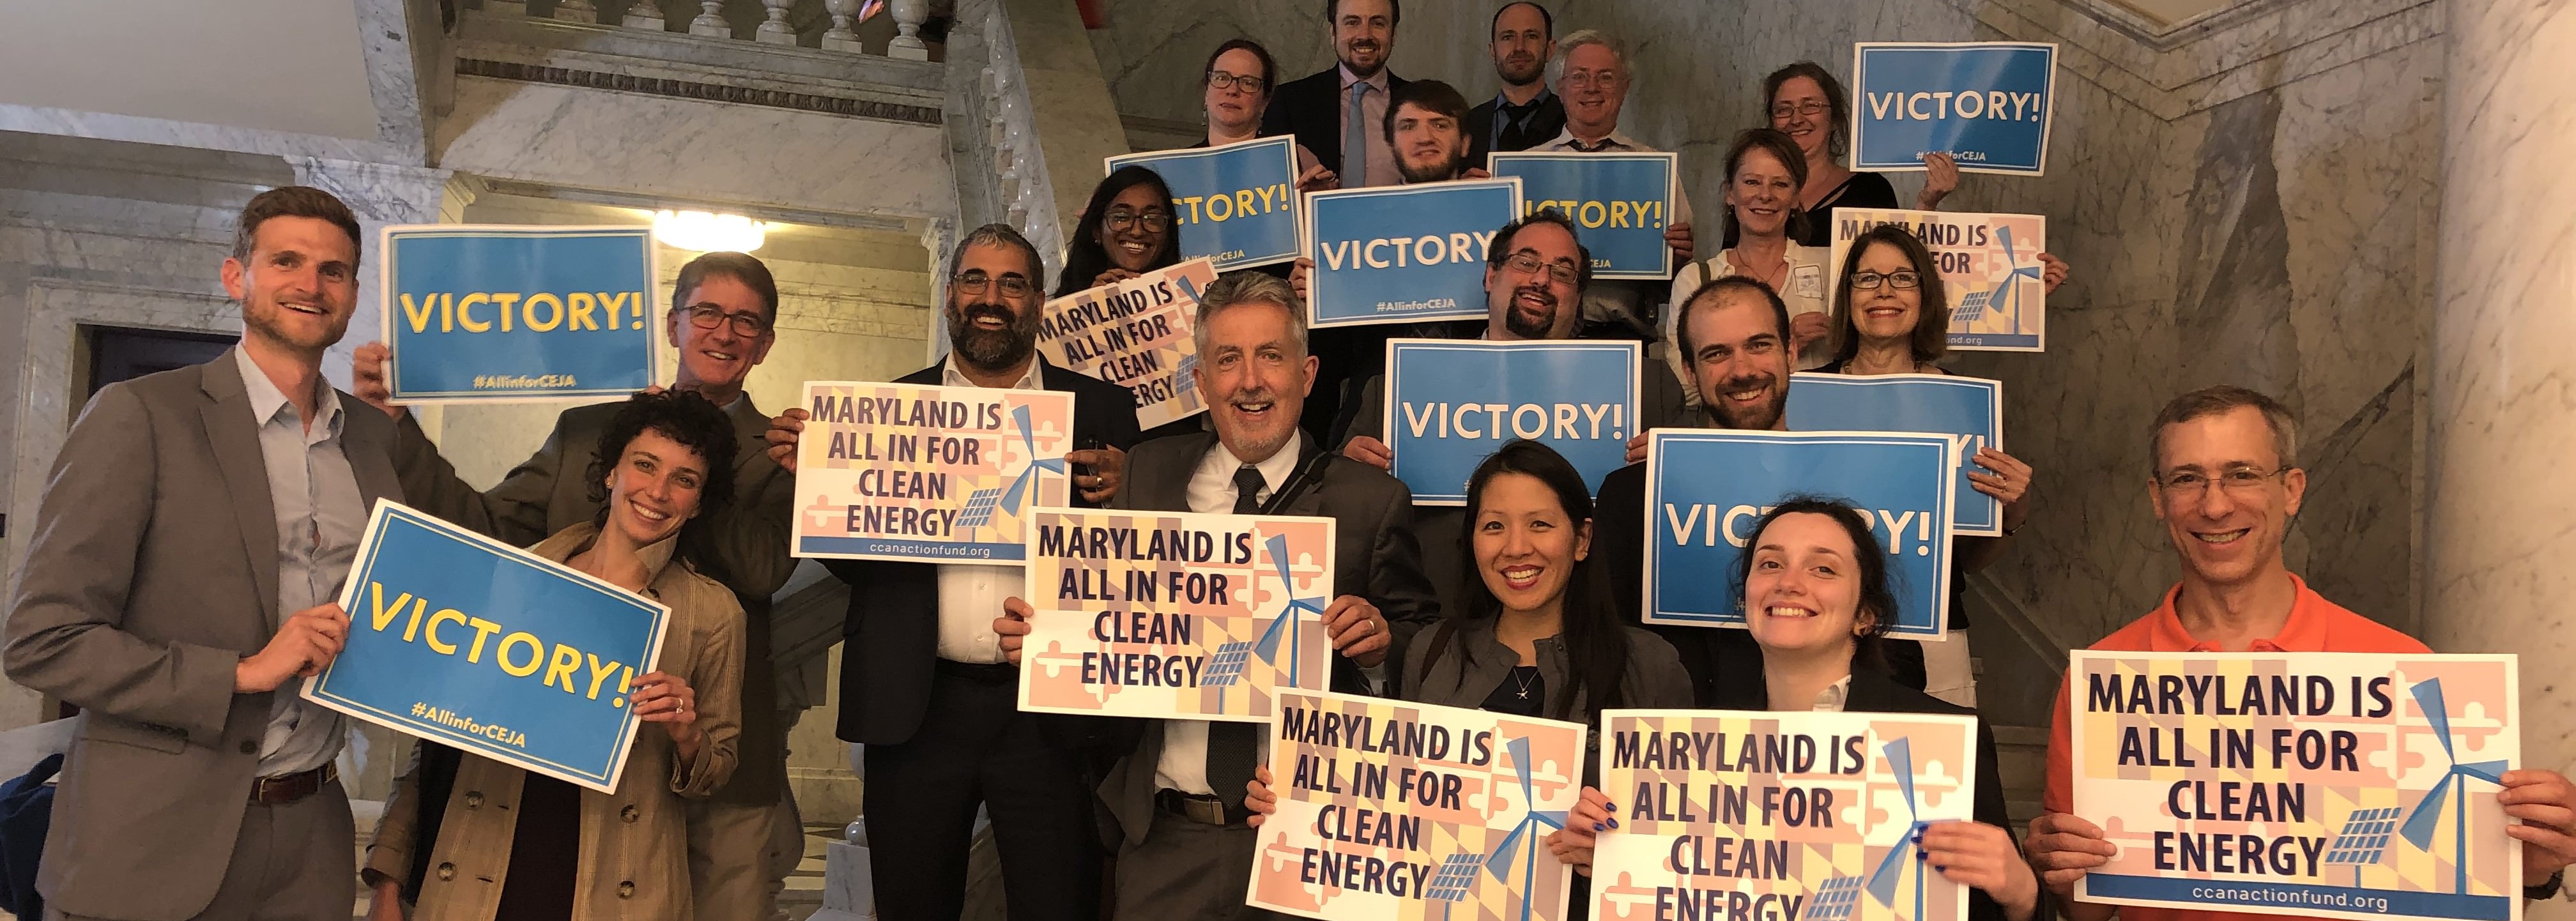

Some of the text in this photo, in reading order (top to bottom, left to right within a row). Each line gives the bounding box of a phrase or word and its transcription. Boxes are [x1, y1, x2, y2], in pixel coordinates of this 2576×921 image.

[1868, 91, 2042, 122] VICTORY!
[1968, 225, 1987, 246] IS
[400, 292, 643, 333] VICTORY!
[1037, 281, 1173, 342] MARYLAND IS
[1376, 299, 1455, 312] #AllinforCEJA
[1064, 314, 1171, 366] ALL IN FOR
[473, 374, 576, 389] #AllinforCEJA
[1100, 349, 1158, 384] CLEAN
[1130, 375, 1174, 408] ERGY
[811, 395, 1000, 430] MARYLAND IS
[1403, 402, 1622, 440] VICTORY!
[828, 431, 979, 466] ALL IN FOR
[859, 469, 946, 501] CLEAN
[847, 505, 957, 537] ENERGY
[870, 544, 990, 558] ccanactionfund.org
[1039, 525, 1252, 565] MARYLAND IS
[1059, 568, 1228, 606] ALL IN FOR
[371, 581, 634, 708] VICTORY!
[1094, 611, 1191, 645] CLEAN
[1081, 652, 1204, 688] ENERGY
[2089, 673, 2391, 719] MARYLAND IS
[411, 702, 525, 748] #AllinforCEJA
[1282, 707, 1491, 766] MARYLAND IS
[1612, 731, 1864, 775] MARYLAND IS
[2118, 727, 2359, 772] ALL IN FOR
[1292, 754, 1462, 811] ALL IN FOR
[2168, 780, 2305, 823] CLEAN
[1631, 782, 1833, 829] ALL IN FOR
[1317, 805, 1420, 852] CLEAN
[1670, 835, 1788, 881] CLEAN
[2154, 831, 2327, 877] ENERGY
[1301, 848, 1430, 900] ENERGY
[1655, 886, 1804, 921] ENERGY
[2192, 885, 2388, 912] ccanactionfund.org
